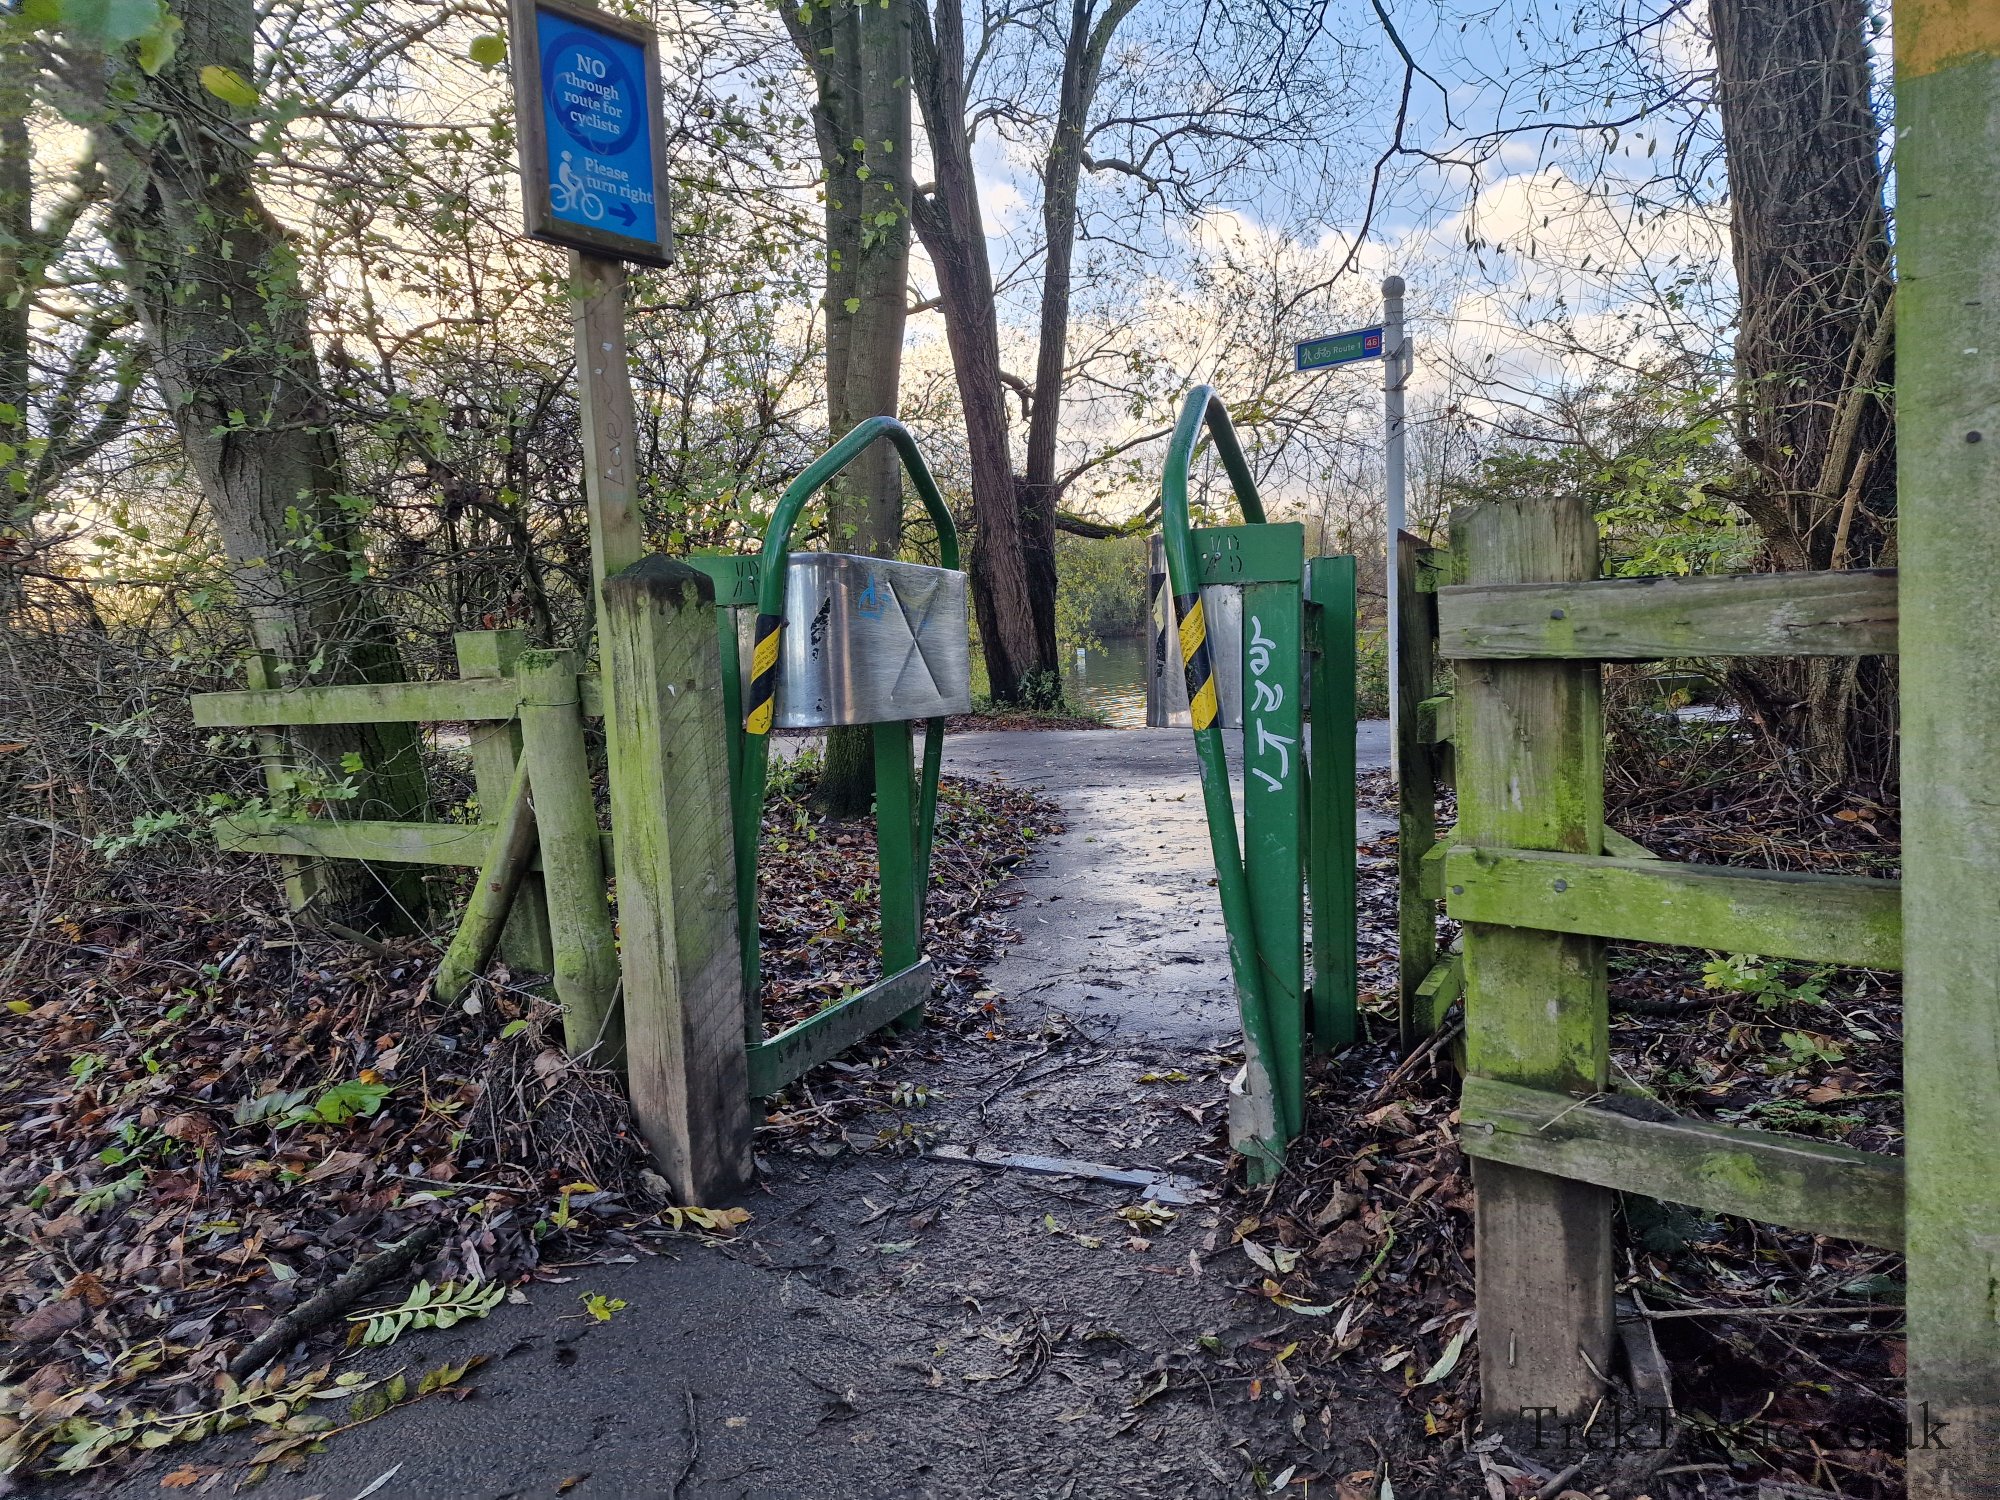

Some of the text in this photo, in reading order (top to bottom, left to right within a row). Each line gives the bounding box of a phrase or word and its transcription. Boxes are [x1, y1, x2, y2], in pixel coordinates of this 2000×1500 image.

[576, 53, 606, 79] NO
[565, 71, 619, 100] through
[564, 90, 622, 118] route for
[570, 111, 620, 135] cyclists
[584, 156, 629, 182] Please
[586, 175, 654, 205] turn right
[1333, 344, 1355, 354] Route
[1366, 338, 1377, 347] 46
[604, 423, 624, 486] Love
